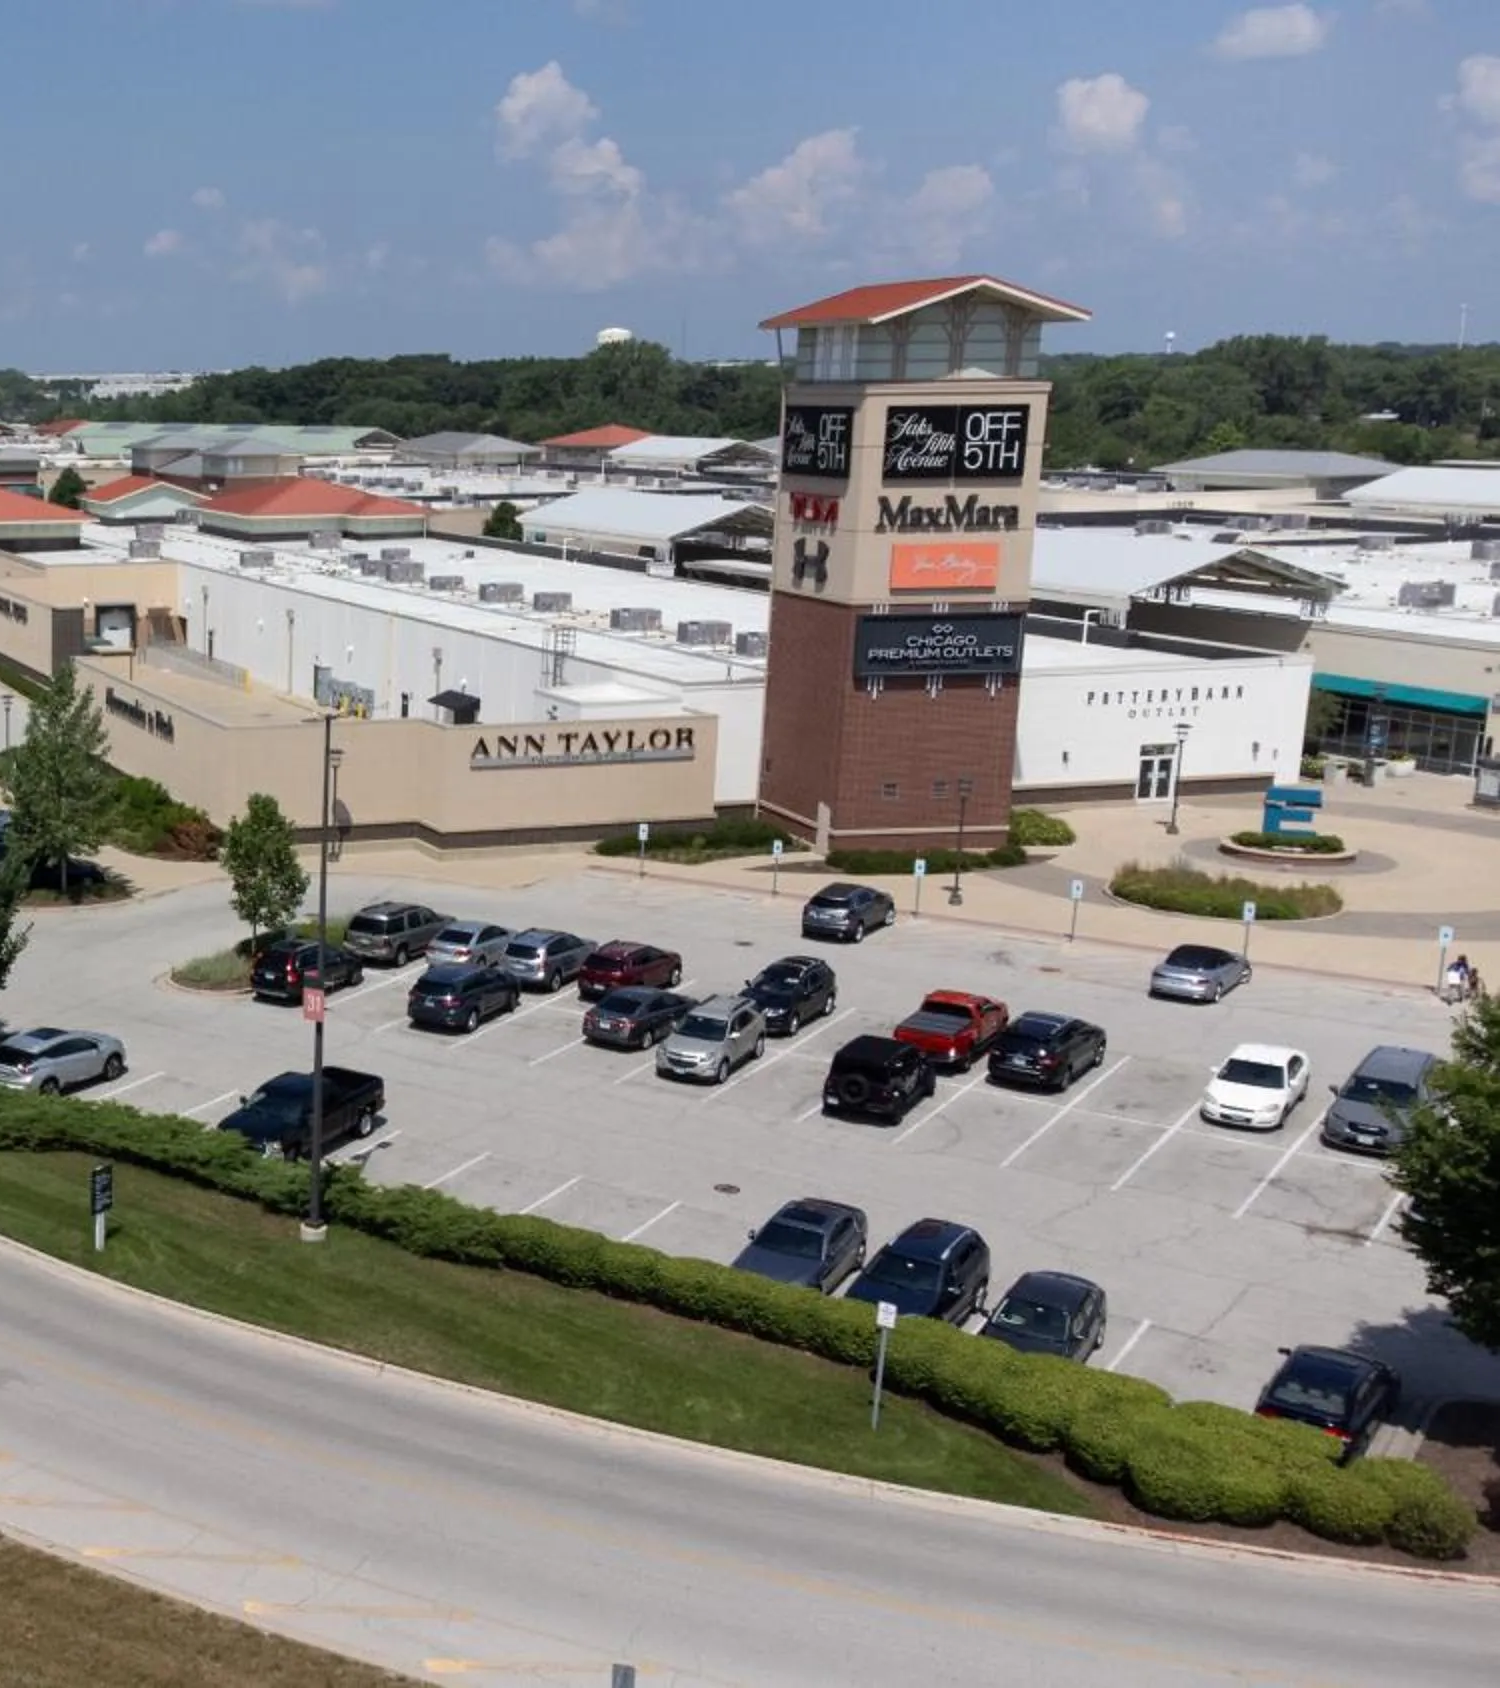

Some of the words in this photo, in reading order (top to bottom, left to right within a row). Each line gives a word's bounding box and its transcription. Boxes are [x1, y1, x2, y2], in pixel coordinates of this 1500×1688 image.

[820, 413, 847, 441] OFF
[885, 412, 933, 442] Saks
[966, 412, 1023, 441] OFF
[817, 441, 845, 469] 5TH
[885, 444, 949, 470] Avenue
[964, 441, 1020, 469] 5TH
[876, 494, 1020, 530] MaxMara
[867, 647, 941, 660] PREMIUM
[943, 645, 1014, 658] OUTLETS
[906, 635, 978, 647] CHICAGO
[1128, 705, 1199, 719] OUTLET
[471, 734, 546, 759] ANN
[557, 727, 694, 756] TAYLOR
